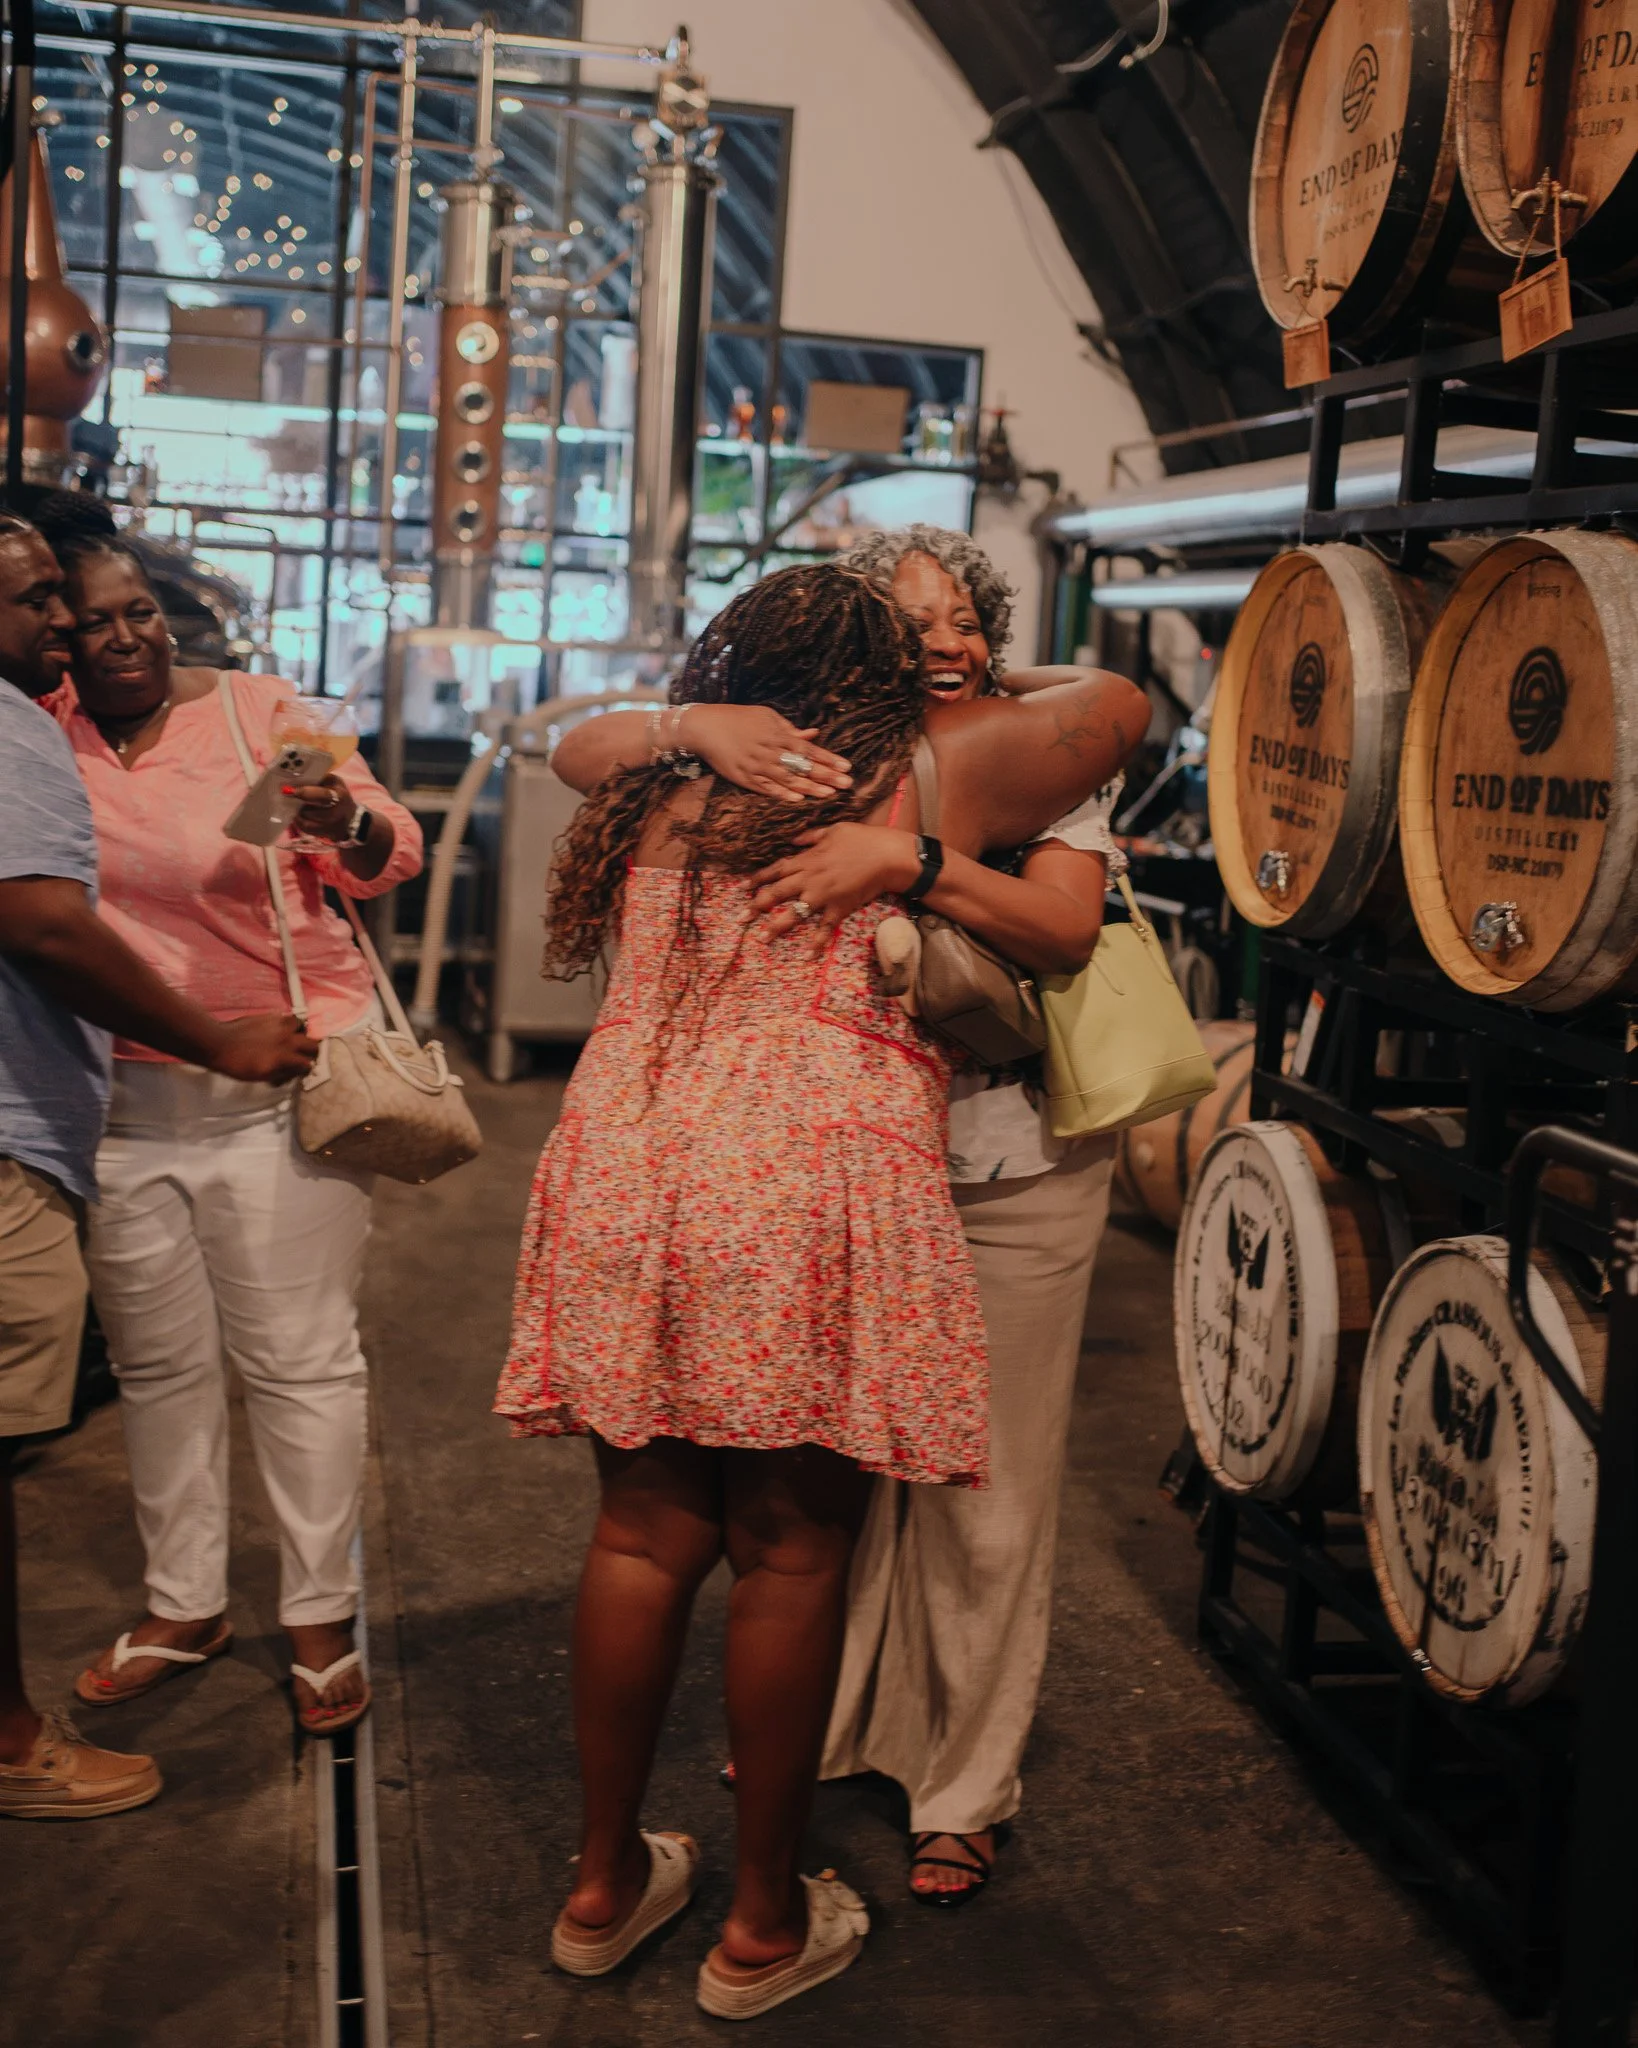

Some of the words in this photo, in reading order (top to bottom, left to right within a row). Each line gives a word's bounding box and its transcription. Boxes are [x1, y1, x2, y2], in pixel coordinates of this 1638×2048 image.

[1580, 34, 1608, 76] OF
[1300, 164, 1336, 206] END
[1341, 150, 1361, 187] OF
[1365, 130, 1402, 174] DAY
[1250, 735, 1286, 769] END
[1287, 745, 1308, 778] OF
[1309, 750, 1351, 790] DAYS
[1452, 773, 1505, 811] END
[1510, 775, 1543, 816] OF
[1545, 777, 1612, 821] DAYS
[1474, 825, 1579, 851] DISTILLERY
